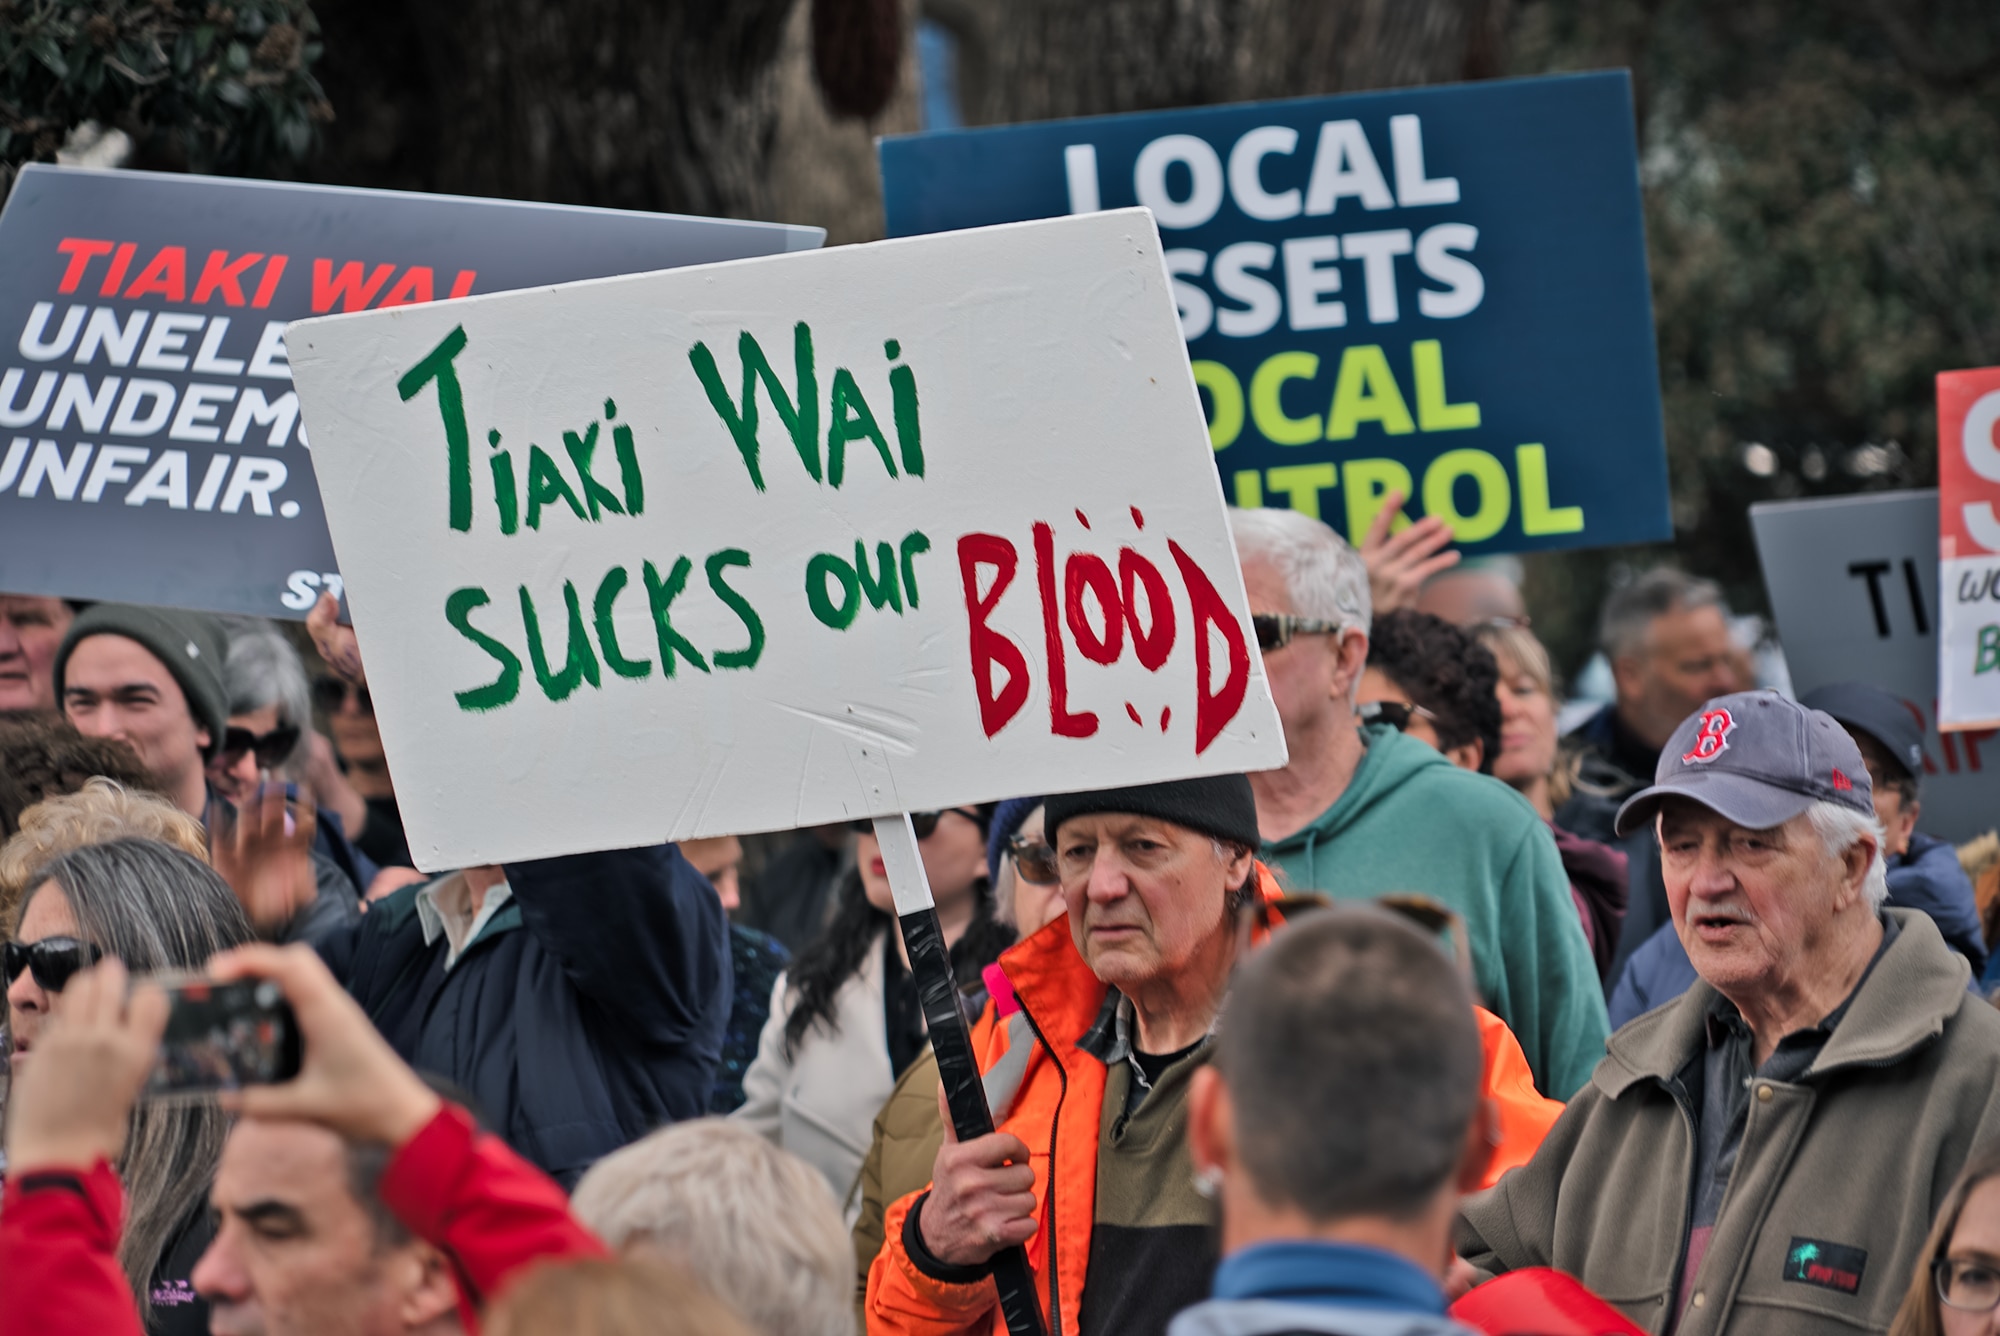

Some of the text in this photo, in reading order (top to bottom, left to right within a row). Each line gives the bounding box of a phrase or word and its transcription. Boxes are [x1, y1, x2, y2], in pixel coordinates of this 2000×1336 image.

[57, 237, 289, 309] TIAKI
[0, 369, 309, 449] UNDEM
[445, 548, 766, 713] SUCKS
[957, 506, 1251, 758] BLOOD
[1682, 708, 1738, 766] B
